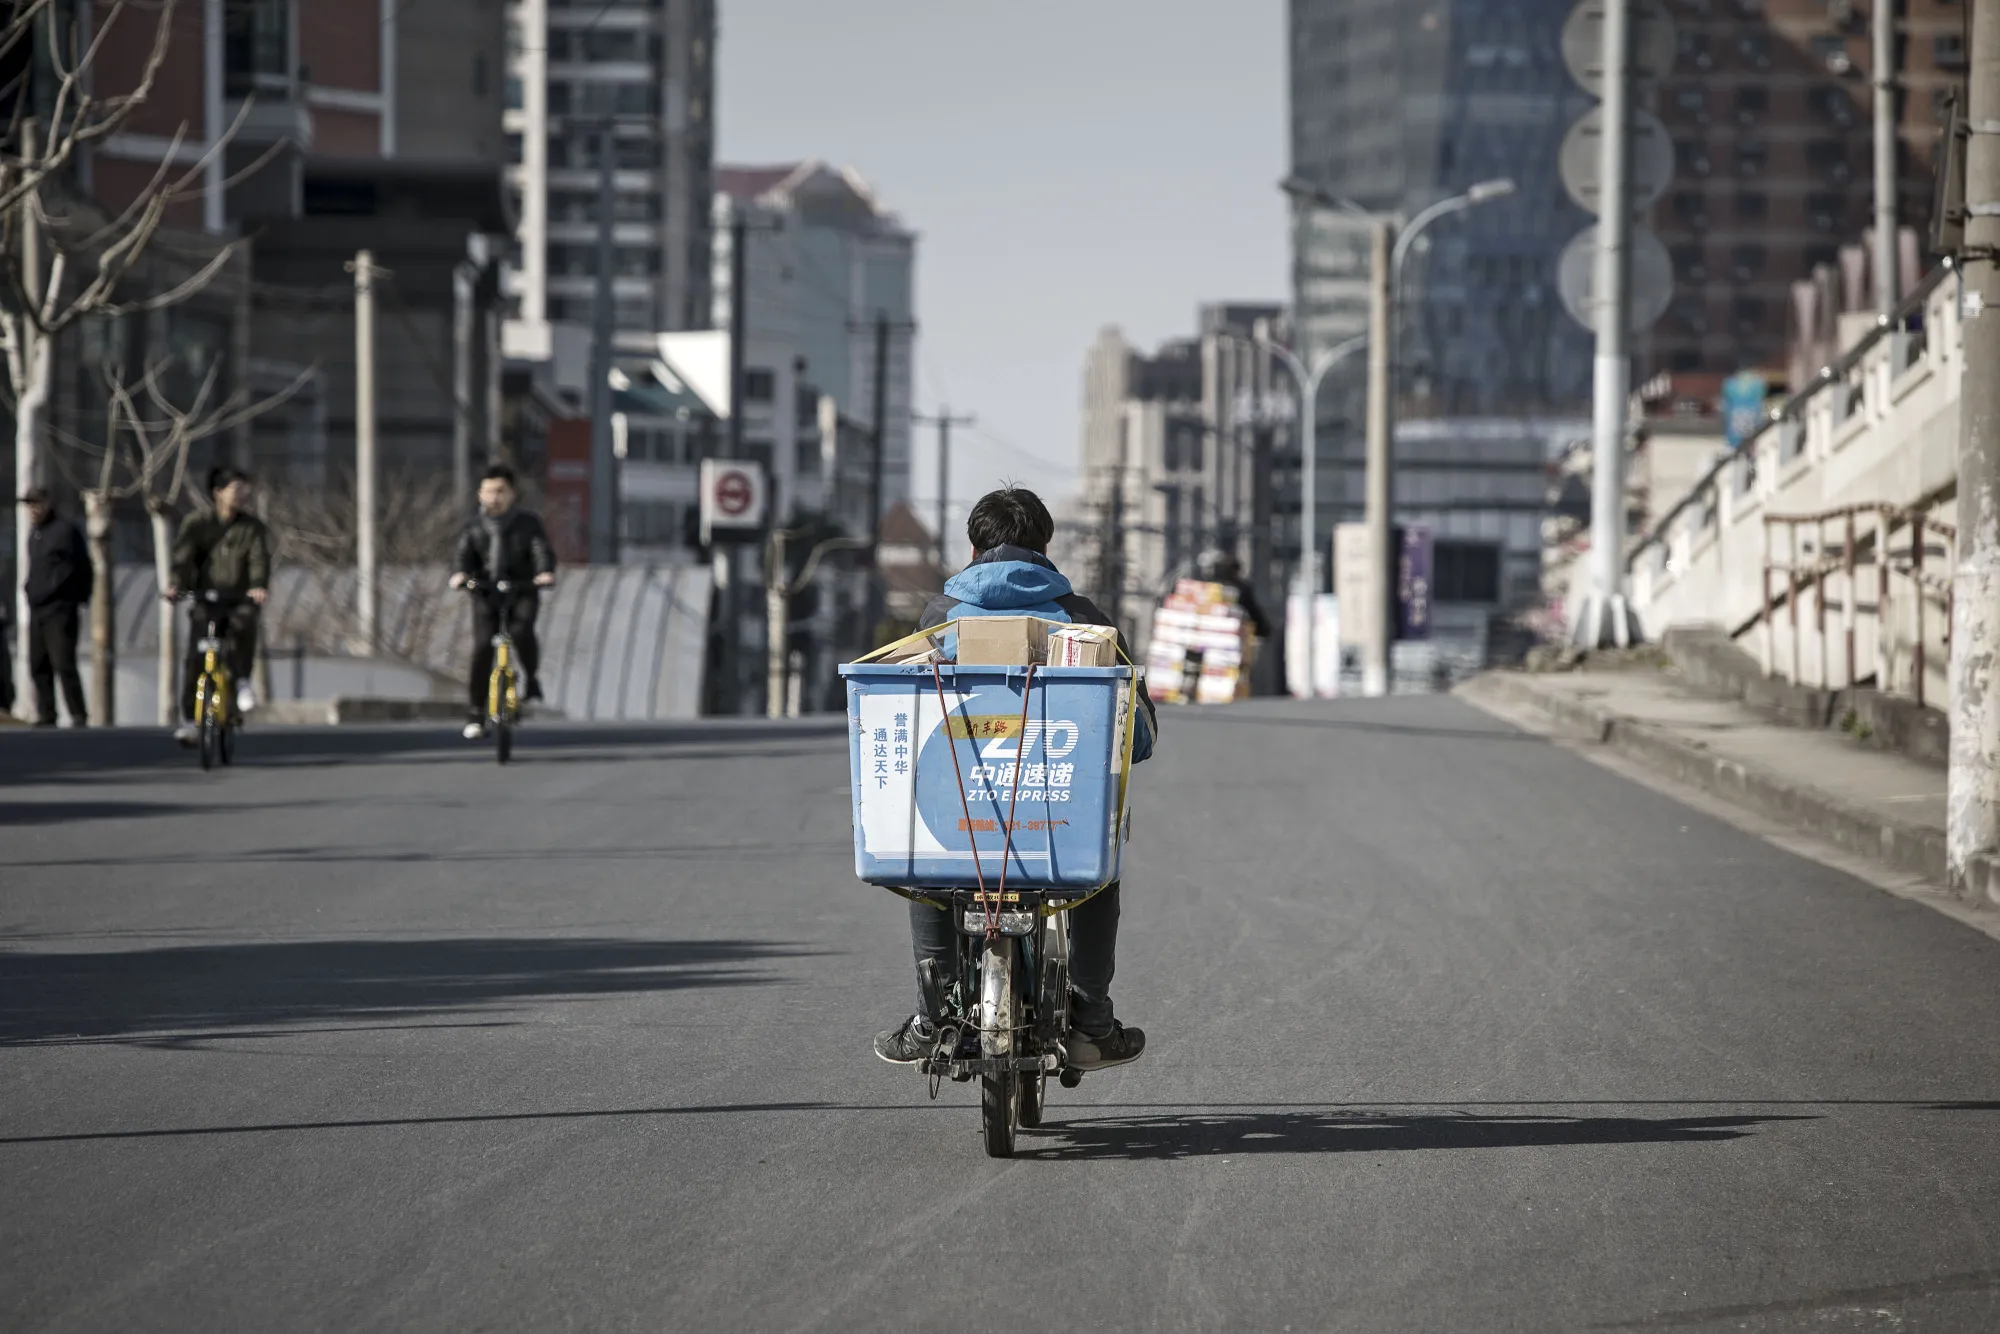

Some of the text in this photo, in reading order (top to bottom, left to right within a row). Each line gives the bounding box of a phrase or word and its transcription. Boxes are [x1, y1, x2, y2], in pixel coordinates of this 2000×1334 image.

[874, 728, 888, 789] 通达天下
[894, 713, 908, 775] 誉满中华
[980, 719, 1079, 759] ZTO
[969, 762, 1075, 787] 中通速递
[967, 789, 1071, 802] ZTO EXPRESS
